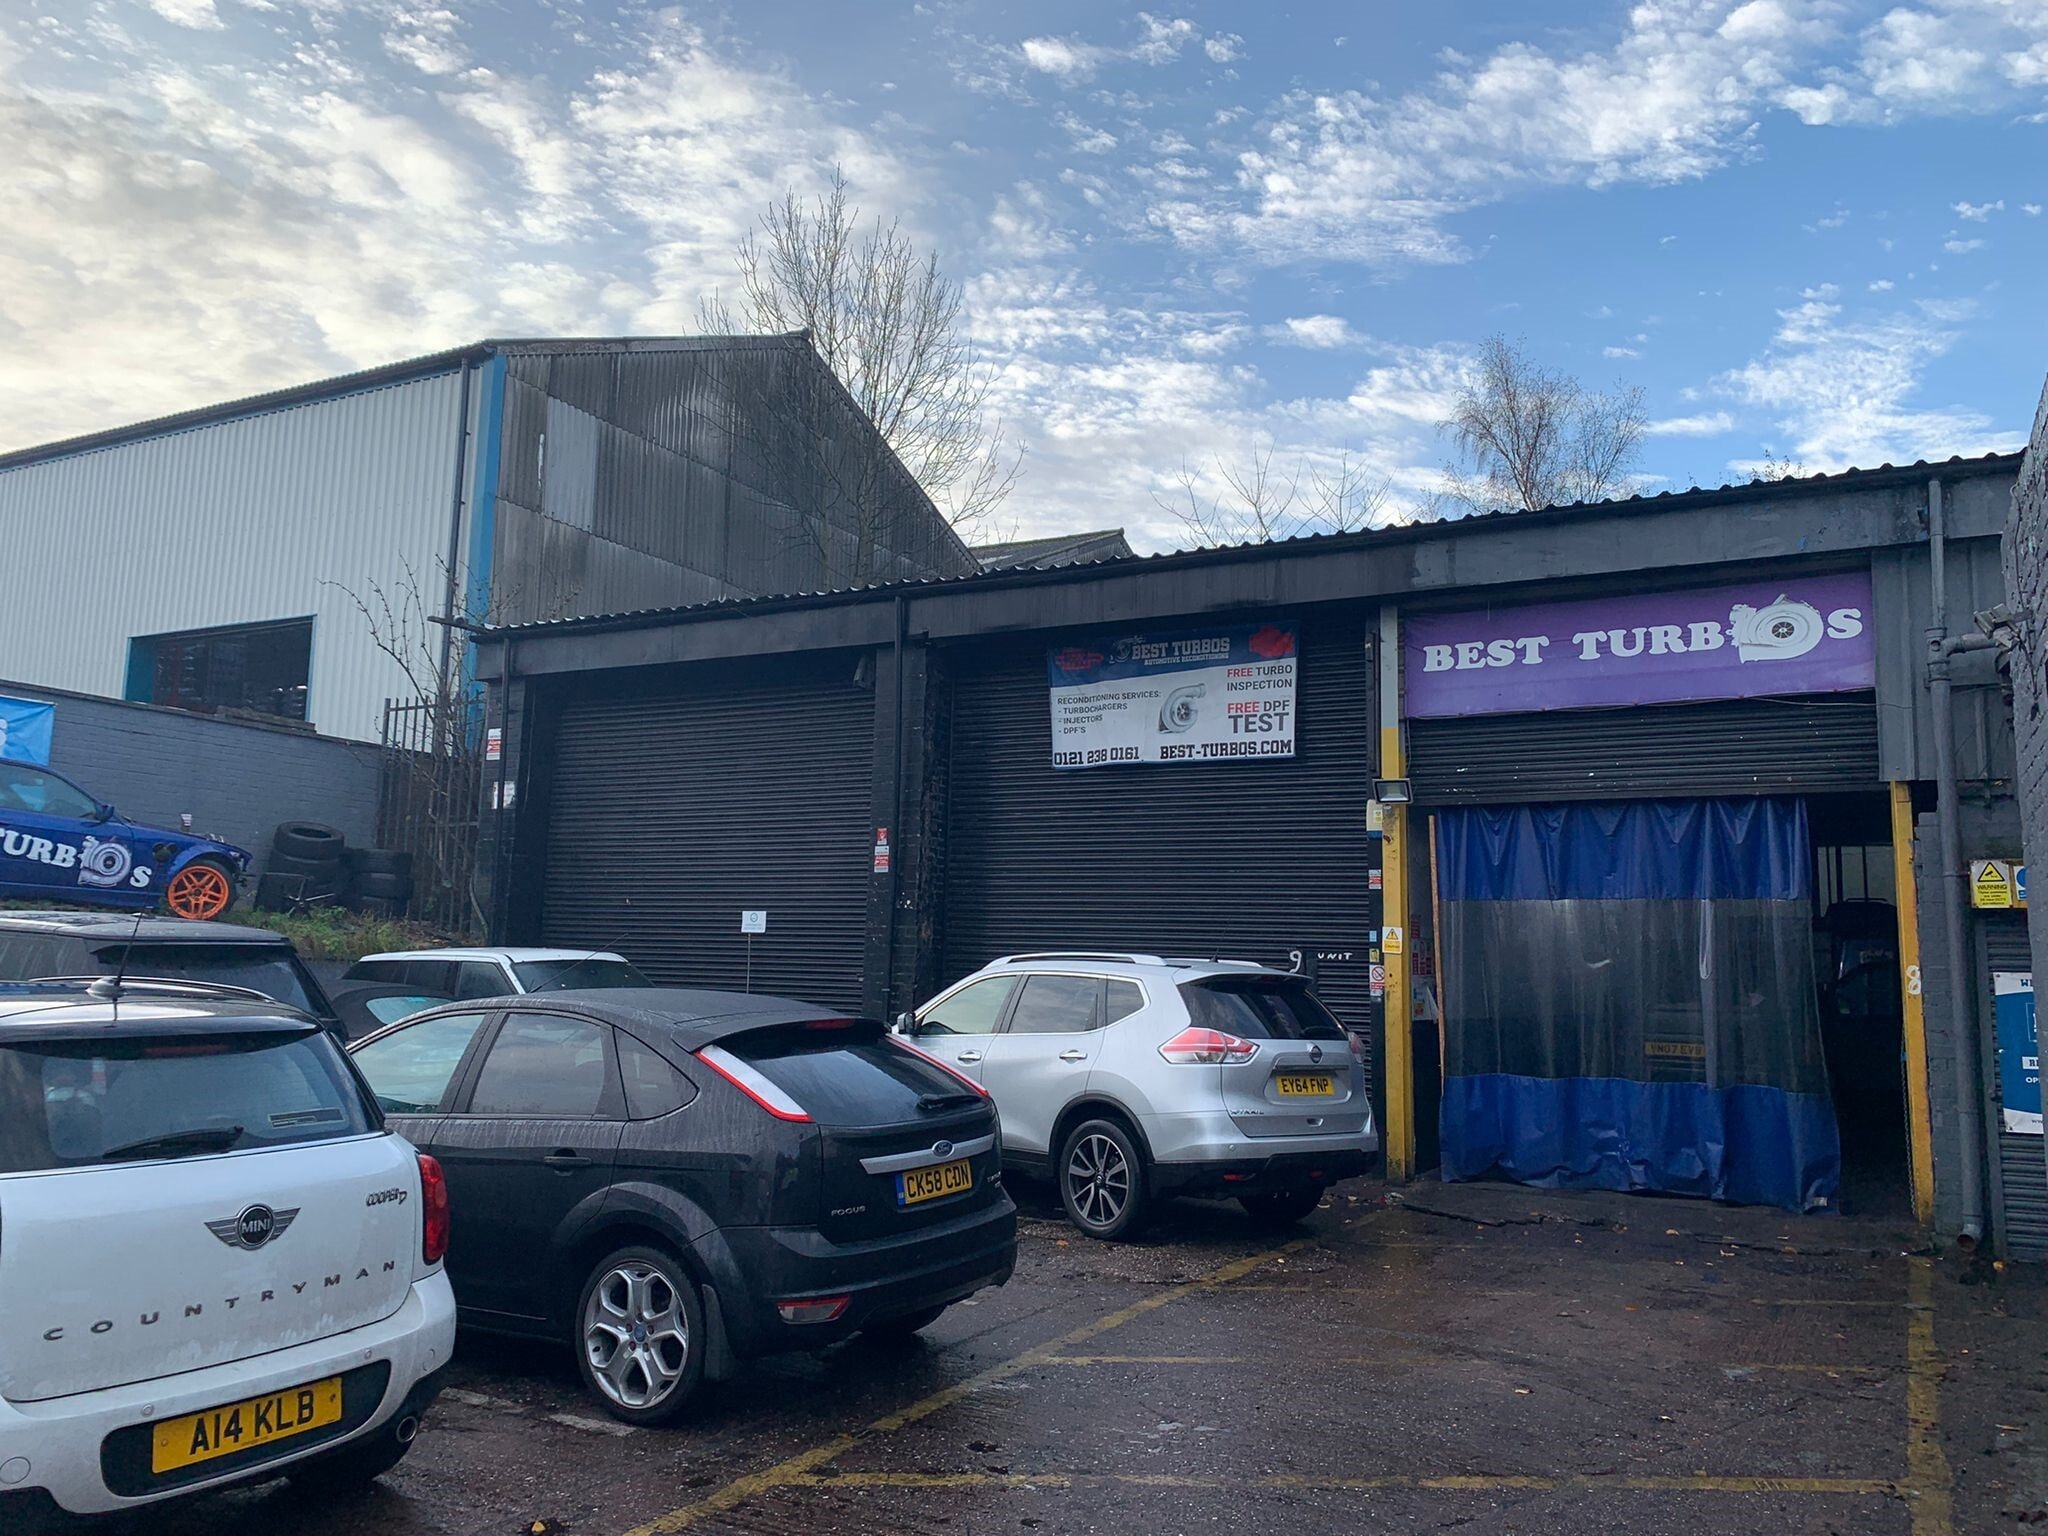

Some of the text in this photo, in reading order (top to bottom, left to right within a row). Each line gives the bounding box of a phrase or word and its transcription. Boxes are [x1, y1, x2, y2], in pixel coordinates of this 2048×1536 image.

[1132, 637, 1230, 660] BEST TURBOS
[1423, 635, 1550, 673] BEST
[1144, 657, 1180, 666] AUTOMOTIVE
[1227, 664, 1293, 678] FREE TURBO
[1226, 678, 1293, 692] INSPECTION
[1057, 690, 1161, 705] RECONDITIONING SERVICES:
[1063, 703, 1128, 715] TURBOCHARGERS
[1227, 700, 1290, 714] FREE DPF
[1063, 714, 1103, 724] INJECTORS
[1228, 712, 1289, 734] TEST
[1063, 726, 1086, 735] DPF'S
[1054, 746, 1140, 766] 0121 238 0161
[1160, 740, 1292, 760] BEST-TURBOS.COM
[0, 827, 152, 888] URBOS
[1317, 952, 1353, 960] UNIT
[1281, 1079, 1329, 1093] EY64 FNP
[906, 1171, 942, 1198] CK58
[945, 1164, 970, 1188] CDN
[366, 1188, 399, 1207] COOPER
[831, 1205, 866, 1216] FOCUS
[241, 1218, 271, 1234] MINI
[43, 1260, 395, 1341] COUNTRYMAN
[188, 1390, 315, 1456] A14 KLB
